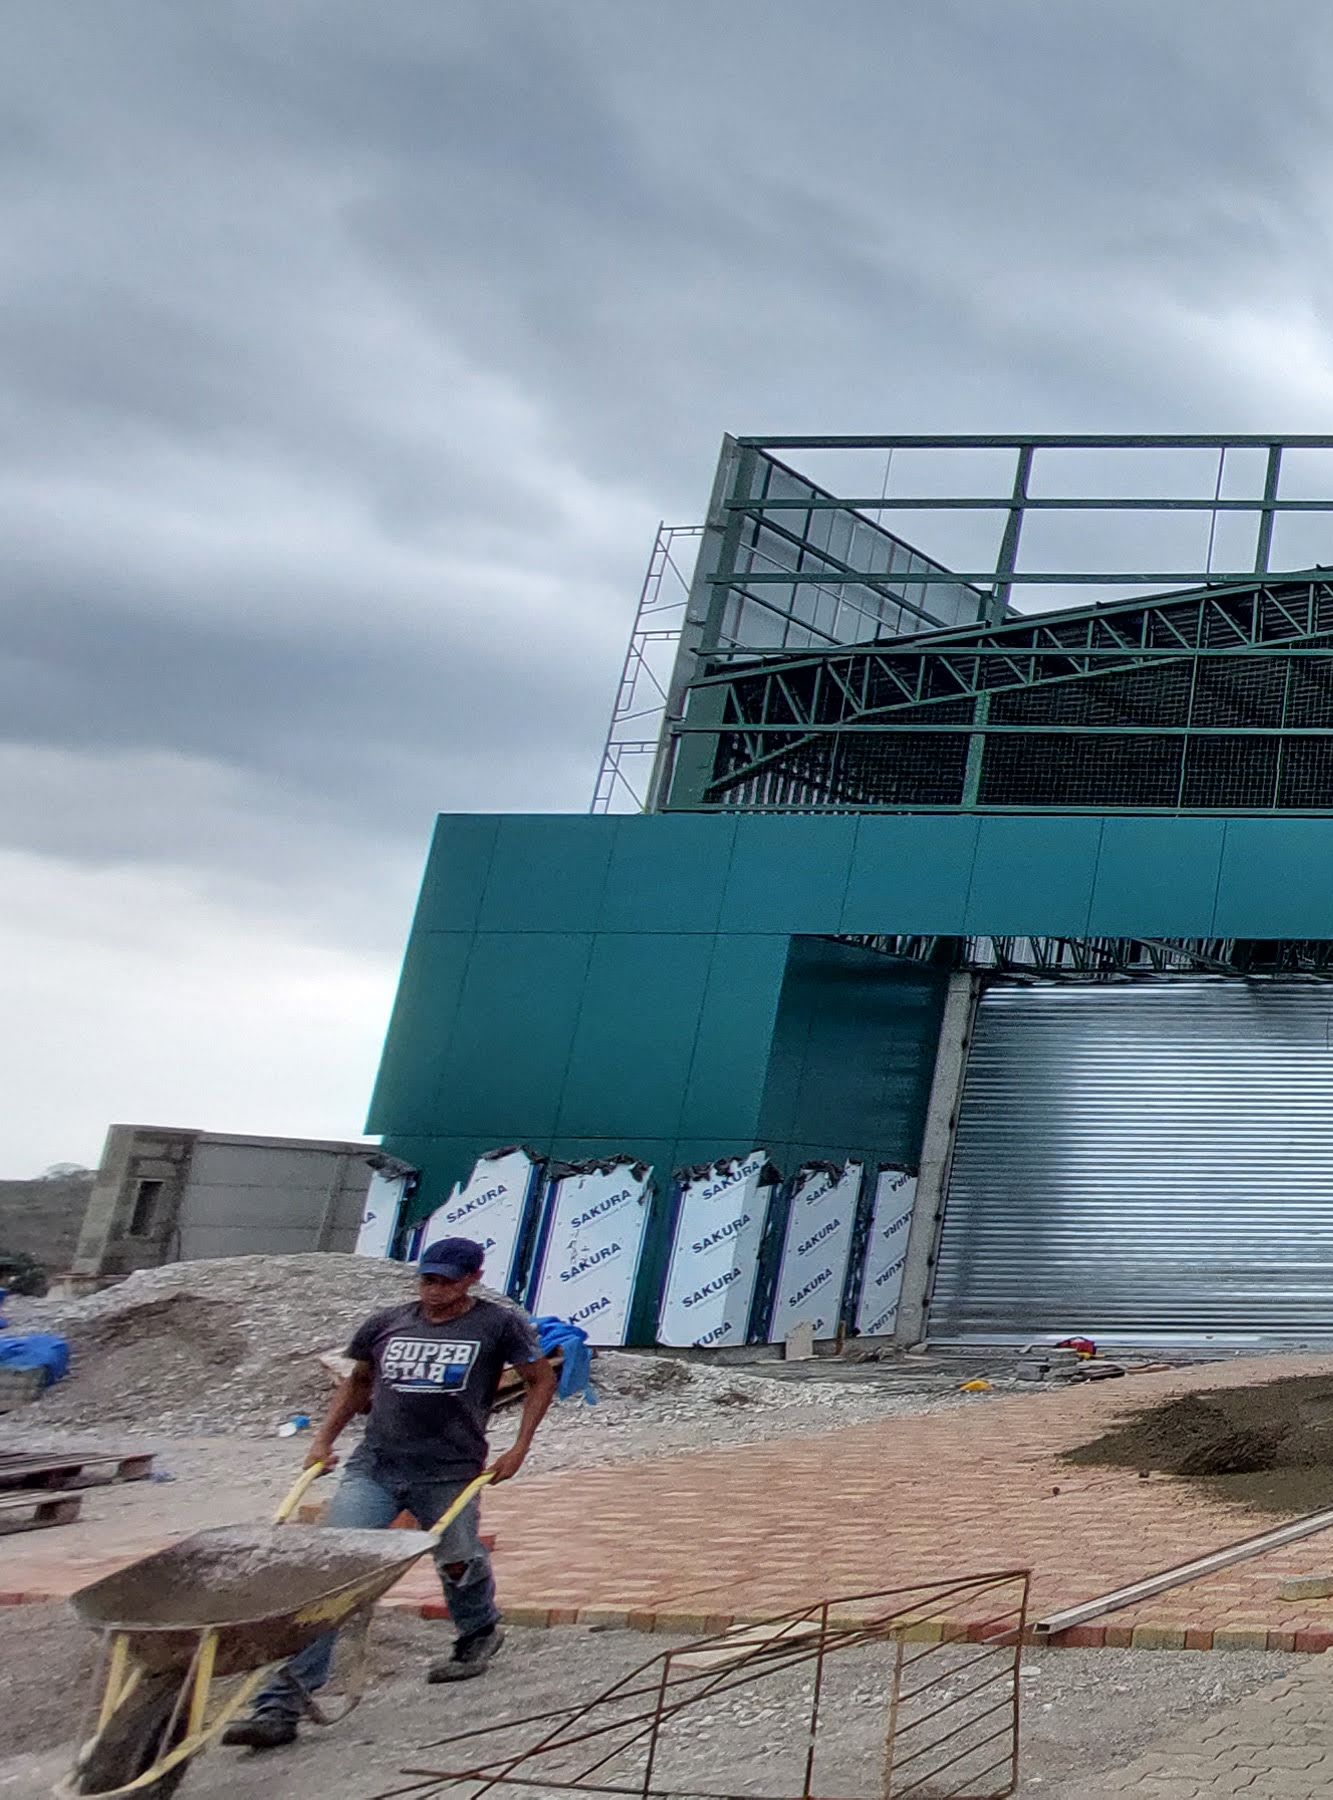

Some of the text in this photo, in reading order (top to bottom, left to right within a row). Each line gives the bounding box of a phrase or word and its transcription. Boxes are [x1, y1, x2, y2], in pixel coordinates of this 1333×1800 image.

[702, 1160, 761, 1200] SAKURA
[446, 1184, 508, 1223] SAKURA
[571, 1189, 632, 1229] SAKURA
[692, 1214, 750, 1254] SAKURA
[797, 1218, 841, 1256] SAKURA
[883, 1210, 915, 1239] KURA
[560, 1242, 621, 1282] SAKURA
[875, 1256, 907, 1287] KURA
[682, 1267, 741, 1308] SAKURA
[789, 1268, 833, 1307] SAKURA
[568, 1296, 611, 1326] KURA
[867, 1304, 900, 1334] KURA
[386, 1341, 472, 1364] SUPER
[381, 1361, 446, 1383] STAR
